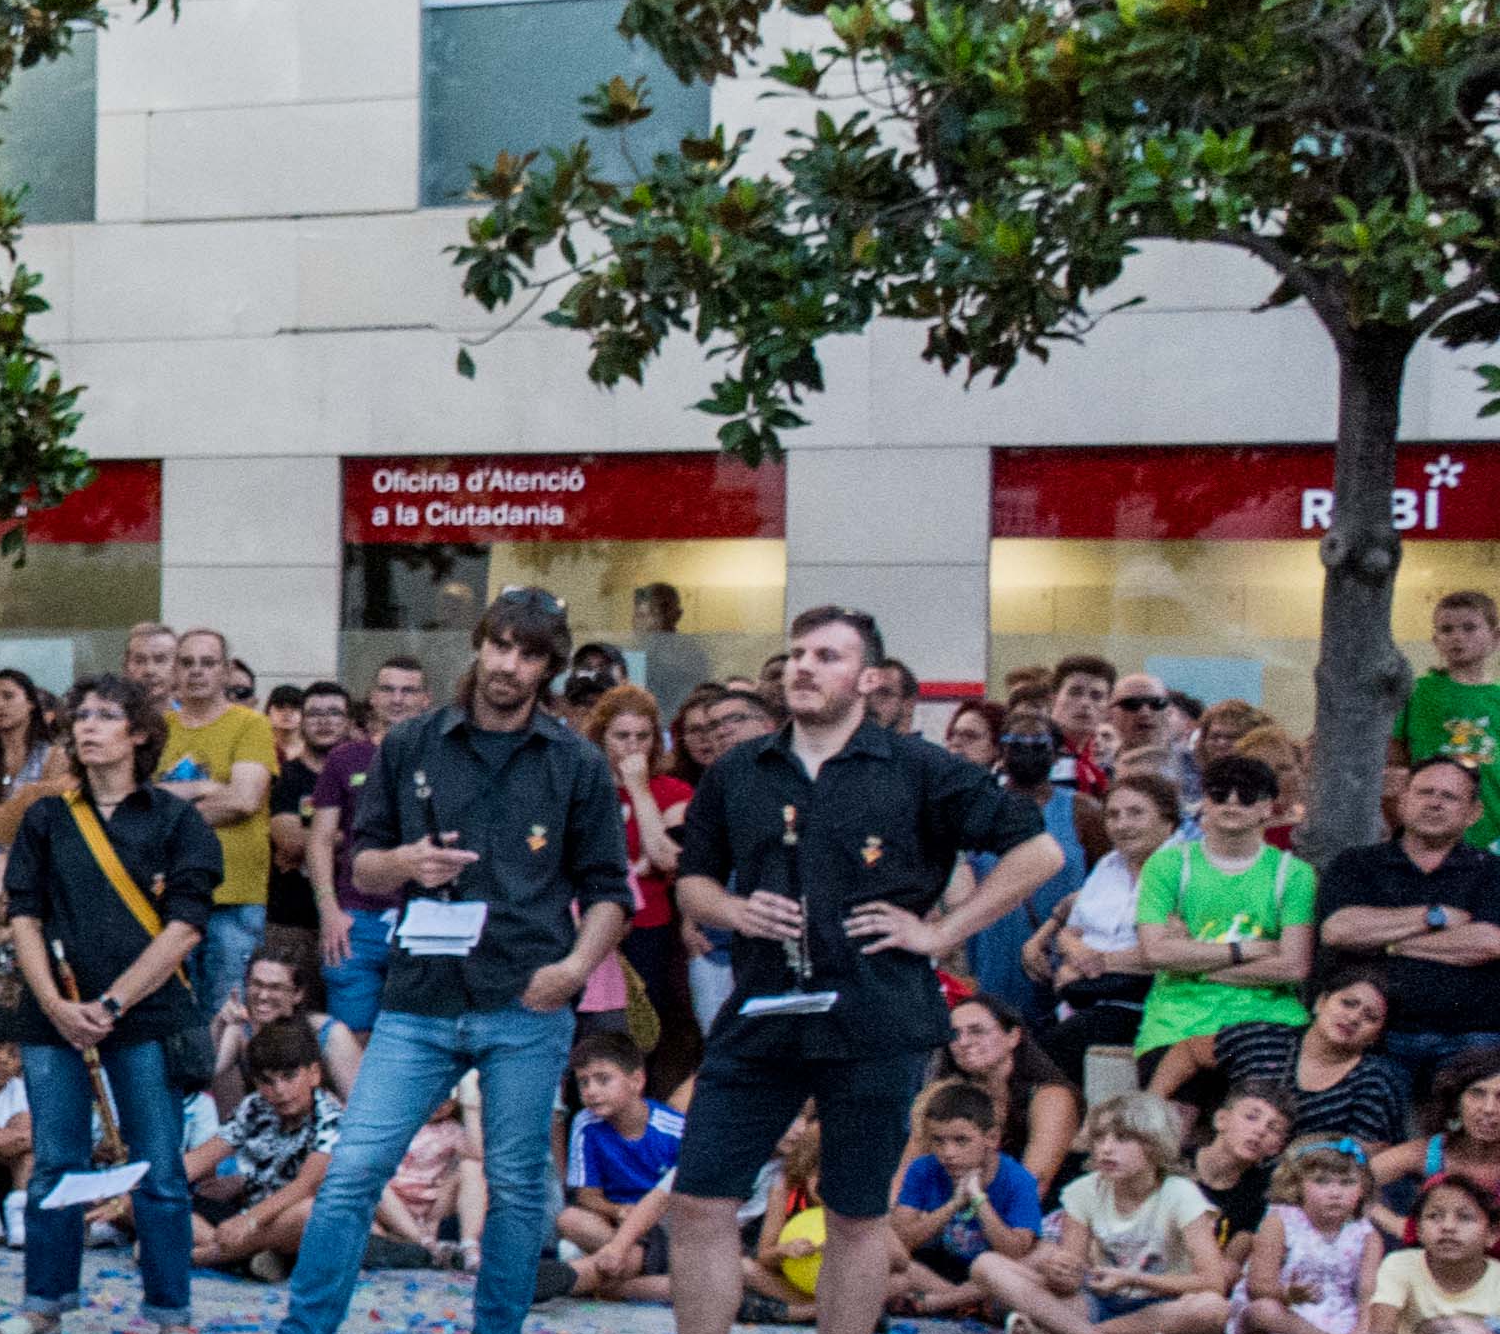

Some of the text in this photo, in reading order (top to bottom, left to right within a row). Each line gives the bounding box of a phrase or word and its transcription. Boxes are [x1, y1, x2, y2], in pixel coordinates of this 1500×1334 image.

[372, 467, 585, 494] Oficina d'Atenció
[371, 501, 564, 527] a la Ciutadania
[1301, 487, 1440, 531] RBI
